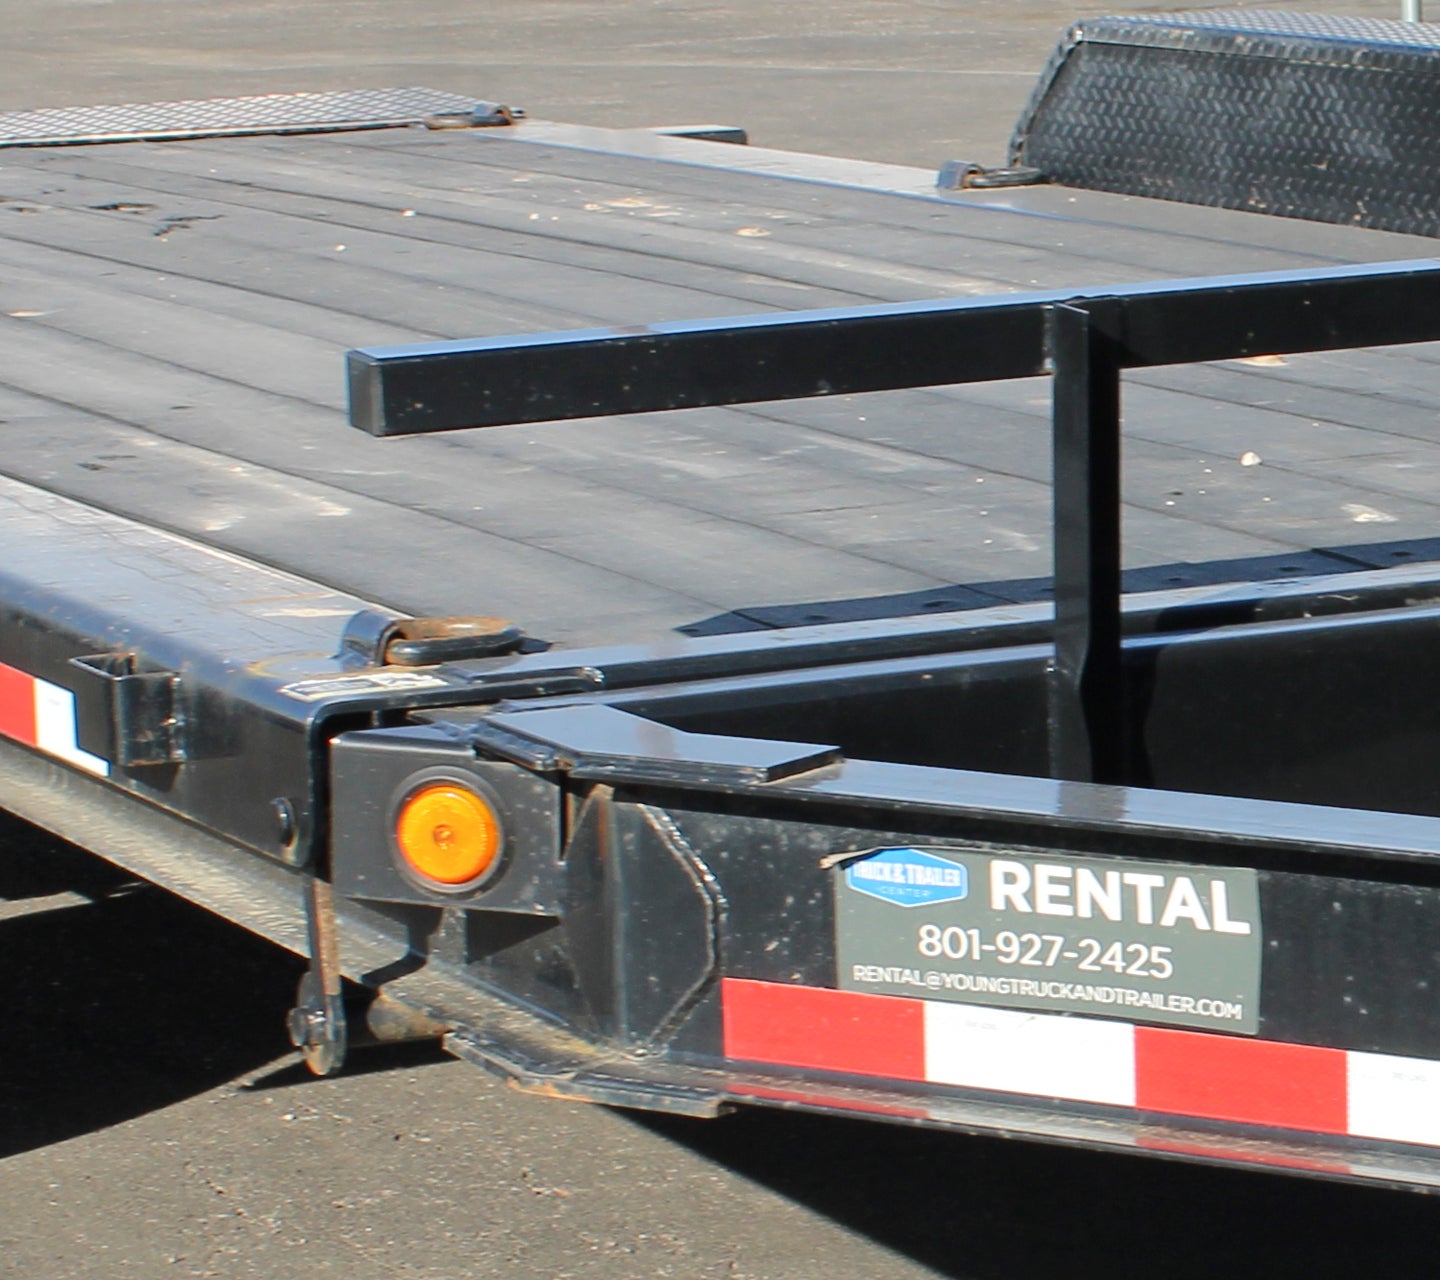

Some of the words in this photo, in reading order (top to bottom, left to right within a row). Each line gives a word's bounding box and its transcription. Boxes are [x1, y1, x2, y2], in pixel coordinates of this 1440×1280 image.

[989, 859, 1252, 935] RENTAL
[917, 924, 1174, 980] 801-927-2425
[852, 964, 1244, 1021] RENTAL@YOUNGTRUCKANDTRAILER.COM
